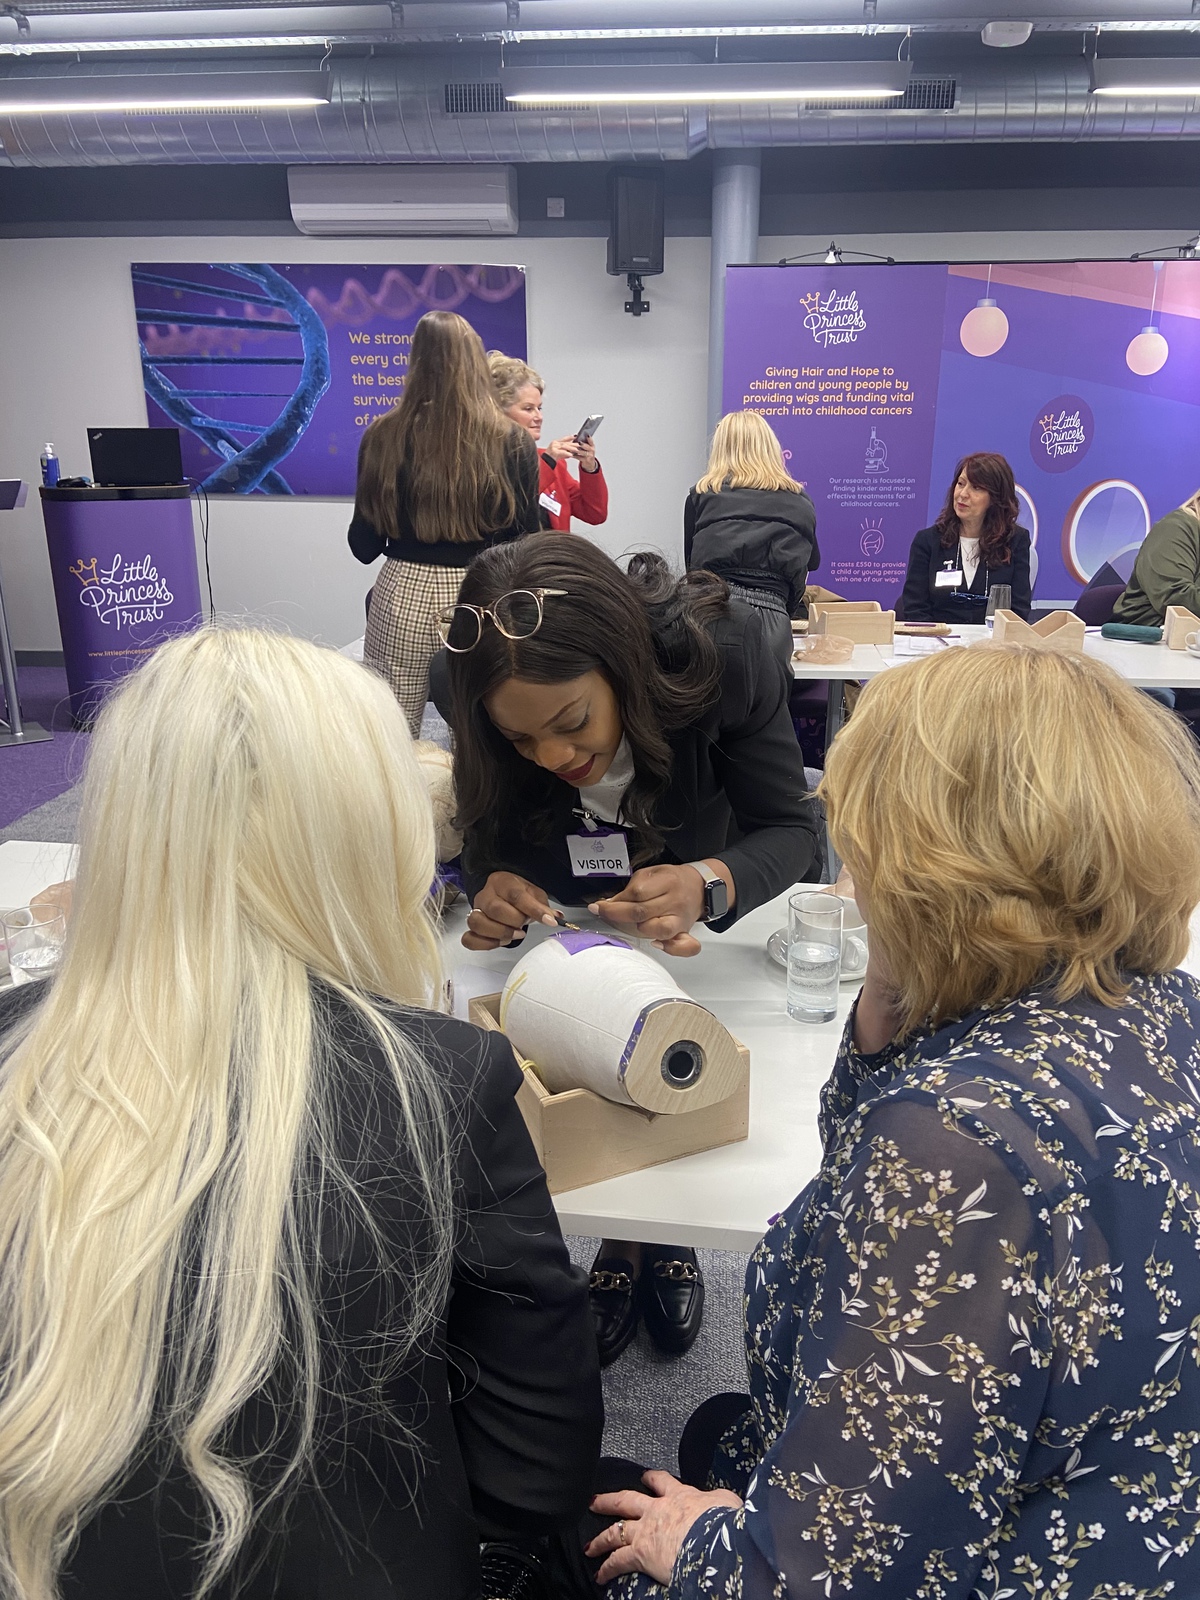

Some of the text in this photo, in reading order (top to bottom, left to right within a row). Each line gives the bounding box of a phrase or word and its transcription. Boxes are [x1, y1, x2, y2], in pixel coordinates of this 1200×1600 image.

[820, 289, 858, 312] Little
[804, 310, 866, 336] Princess
[348, 332, 370, 344] We
[814, 327, 858, 348] Trust
[350, 352, 410, 368] every chi
[352, 372, 406, 386] the best
[766, 366, 894, 378] Giving Hair and Hope to
[750, 379, 908, 391] children and young people by
[743, 392, 914, 404] providing wigs and funding vital
[792, 406, 812, 415] into
[816, 406, 867, 415] childhood
[870, 406, 912, 415] cancers
[354, 413, 370, 426] of
[1053, 410, 1080, 430] Little
[1040, 426, 1086, 450] Princess
[1048, 440, 1078, 458] Trust
[100, 553, 158, 585] Little
[80, 578, 174, 617] Princess
[100, 602, 164, 630] Trust
[577, 859, 624, 870] VISITOR
